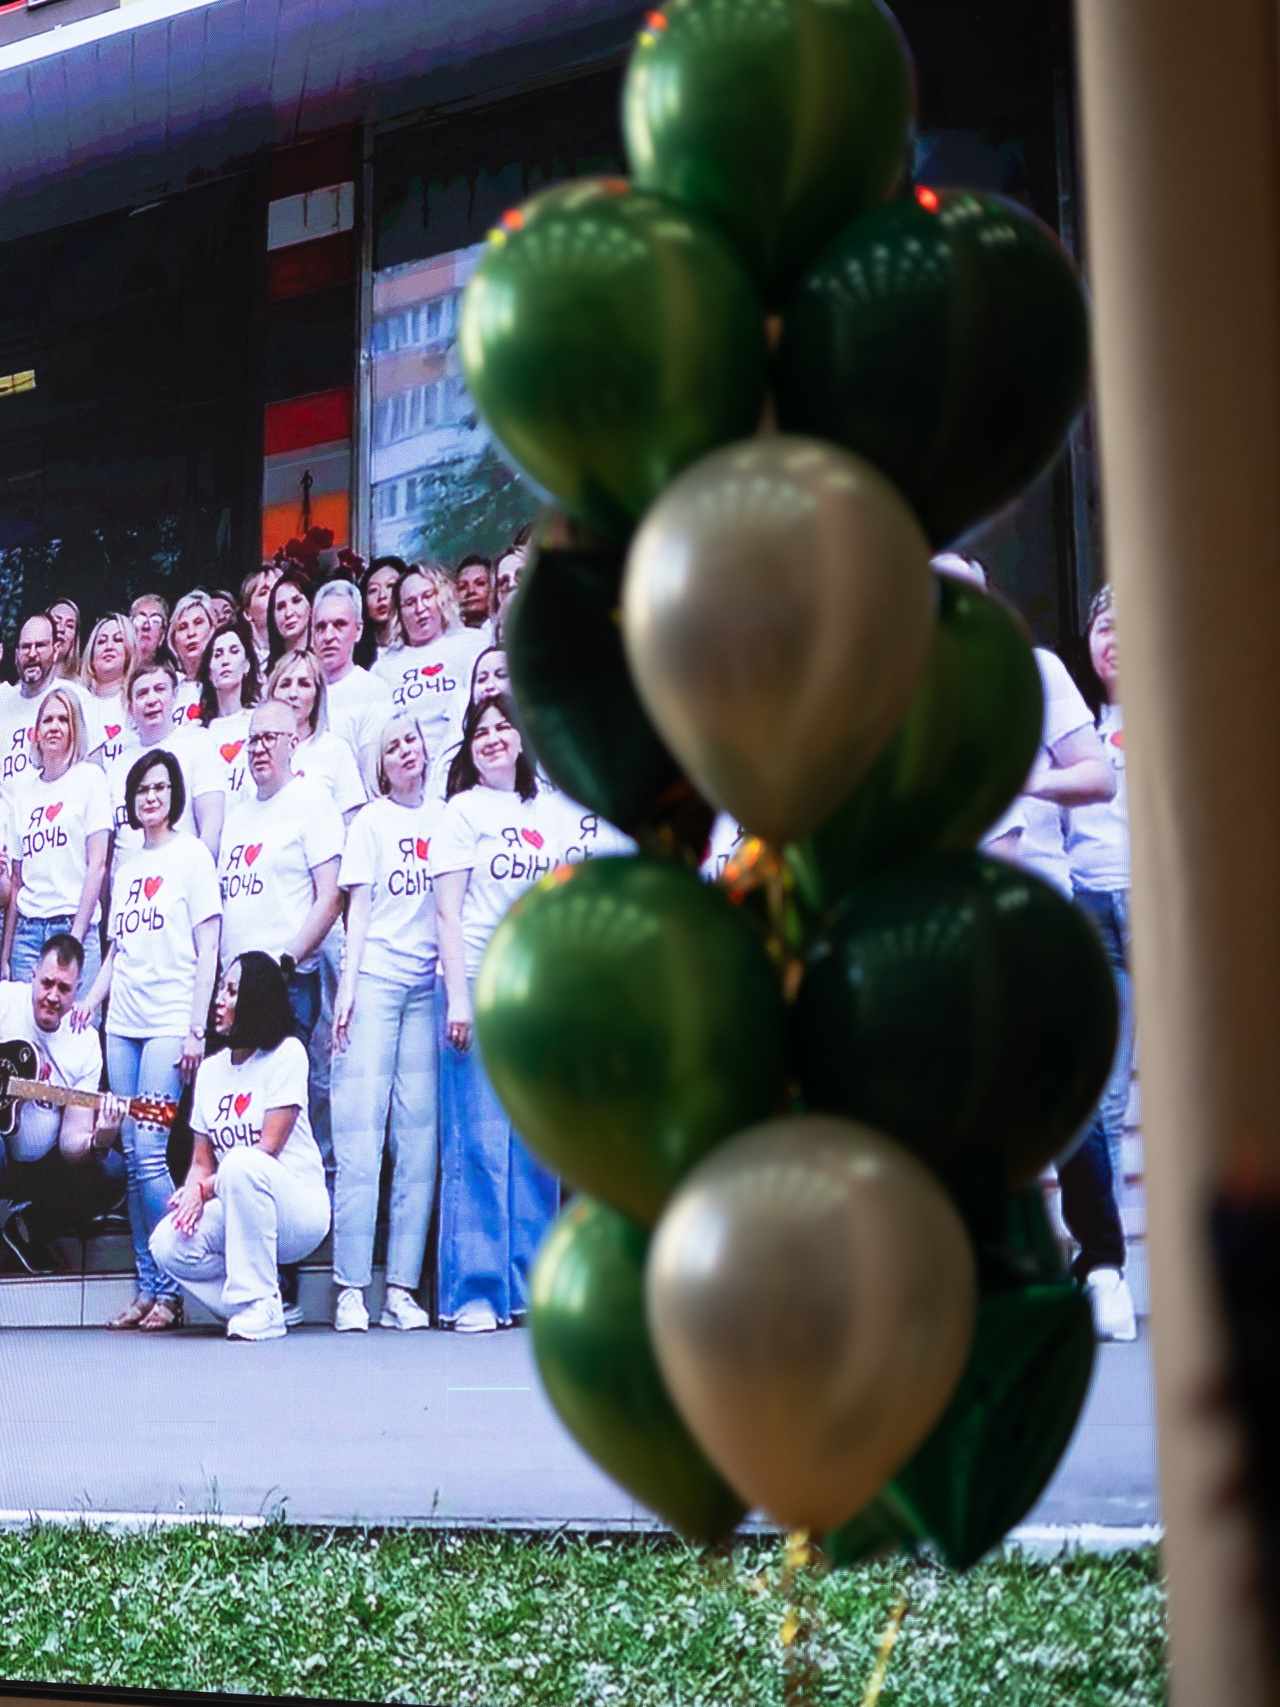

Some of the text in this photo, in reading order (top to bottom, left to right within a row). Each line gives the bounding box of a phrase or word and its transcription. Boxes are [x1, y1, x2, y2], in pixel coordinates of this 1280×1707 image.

[403, 668, 419, 684] Я
[392, 676, 457, 706] ДОЧЬ
[11, 727, 26, 751] Я
[3, 753, 28, 781] ДО
[28, 806, 45, 830] Я
[580, 814, 598, 839] Я
[22, 826, 68, 858] ДОЧЬ
[399, 837, 415, 864] Я
[502, 826, 522, 849] Я
[226, 844, 245, 871] Я
[490, 853, 558, 881] СЫН
[125, 877, 143, 906] Я
[388, 868, 434, 896] СЫН
[214, 1092, 234, 1122] Я
[208, 1122, 262, 1154] ДОЧЬ
